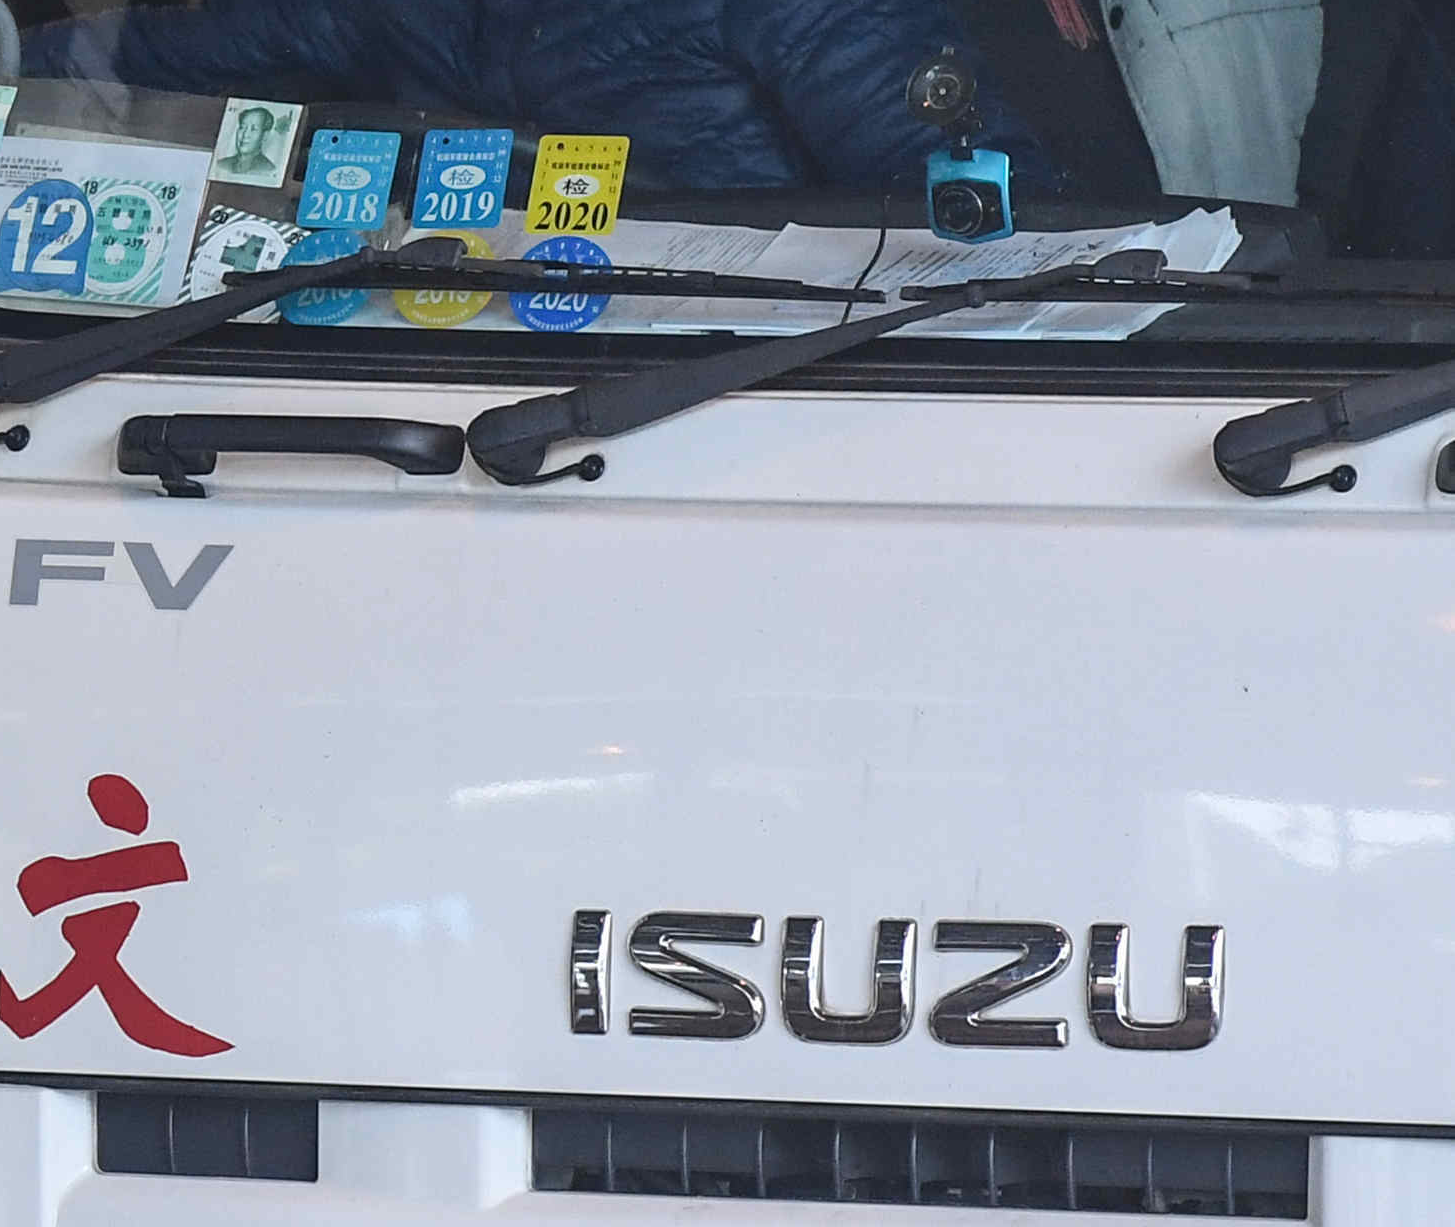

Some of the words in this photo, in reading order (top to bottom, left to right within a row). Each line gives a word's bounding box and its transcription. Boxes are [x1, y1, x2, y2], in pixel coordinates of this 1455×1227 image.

[83, 180, 98, 195] 18
[161, 185, 177, 200] 18
[448, 169, 475, 186] 检
[563, 178, 590, 195] 检
[306, 192, 379, 222] 2018
[420, 192, 495, 221] 2019
[534, 201, 608, 231] 2020
[7, 196, 88, 275] 12
[88, 194, 151, 283] 8
[9, 538, 235, 610] FV
[569, 908, 1228, 1051] ISUZU
